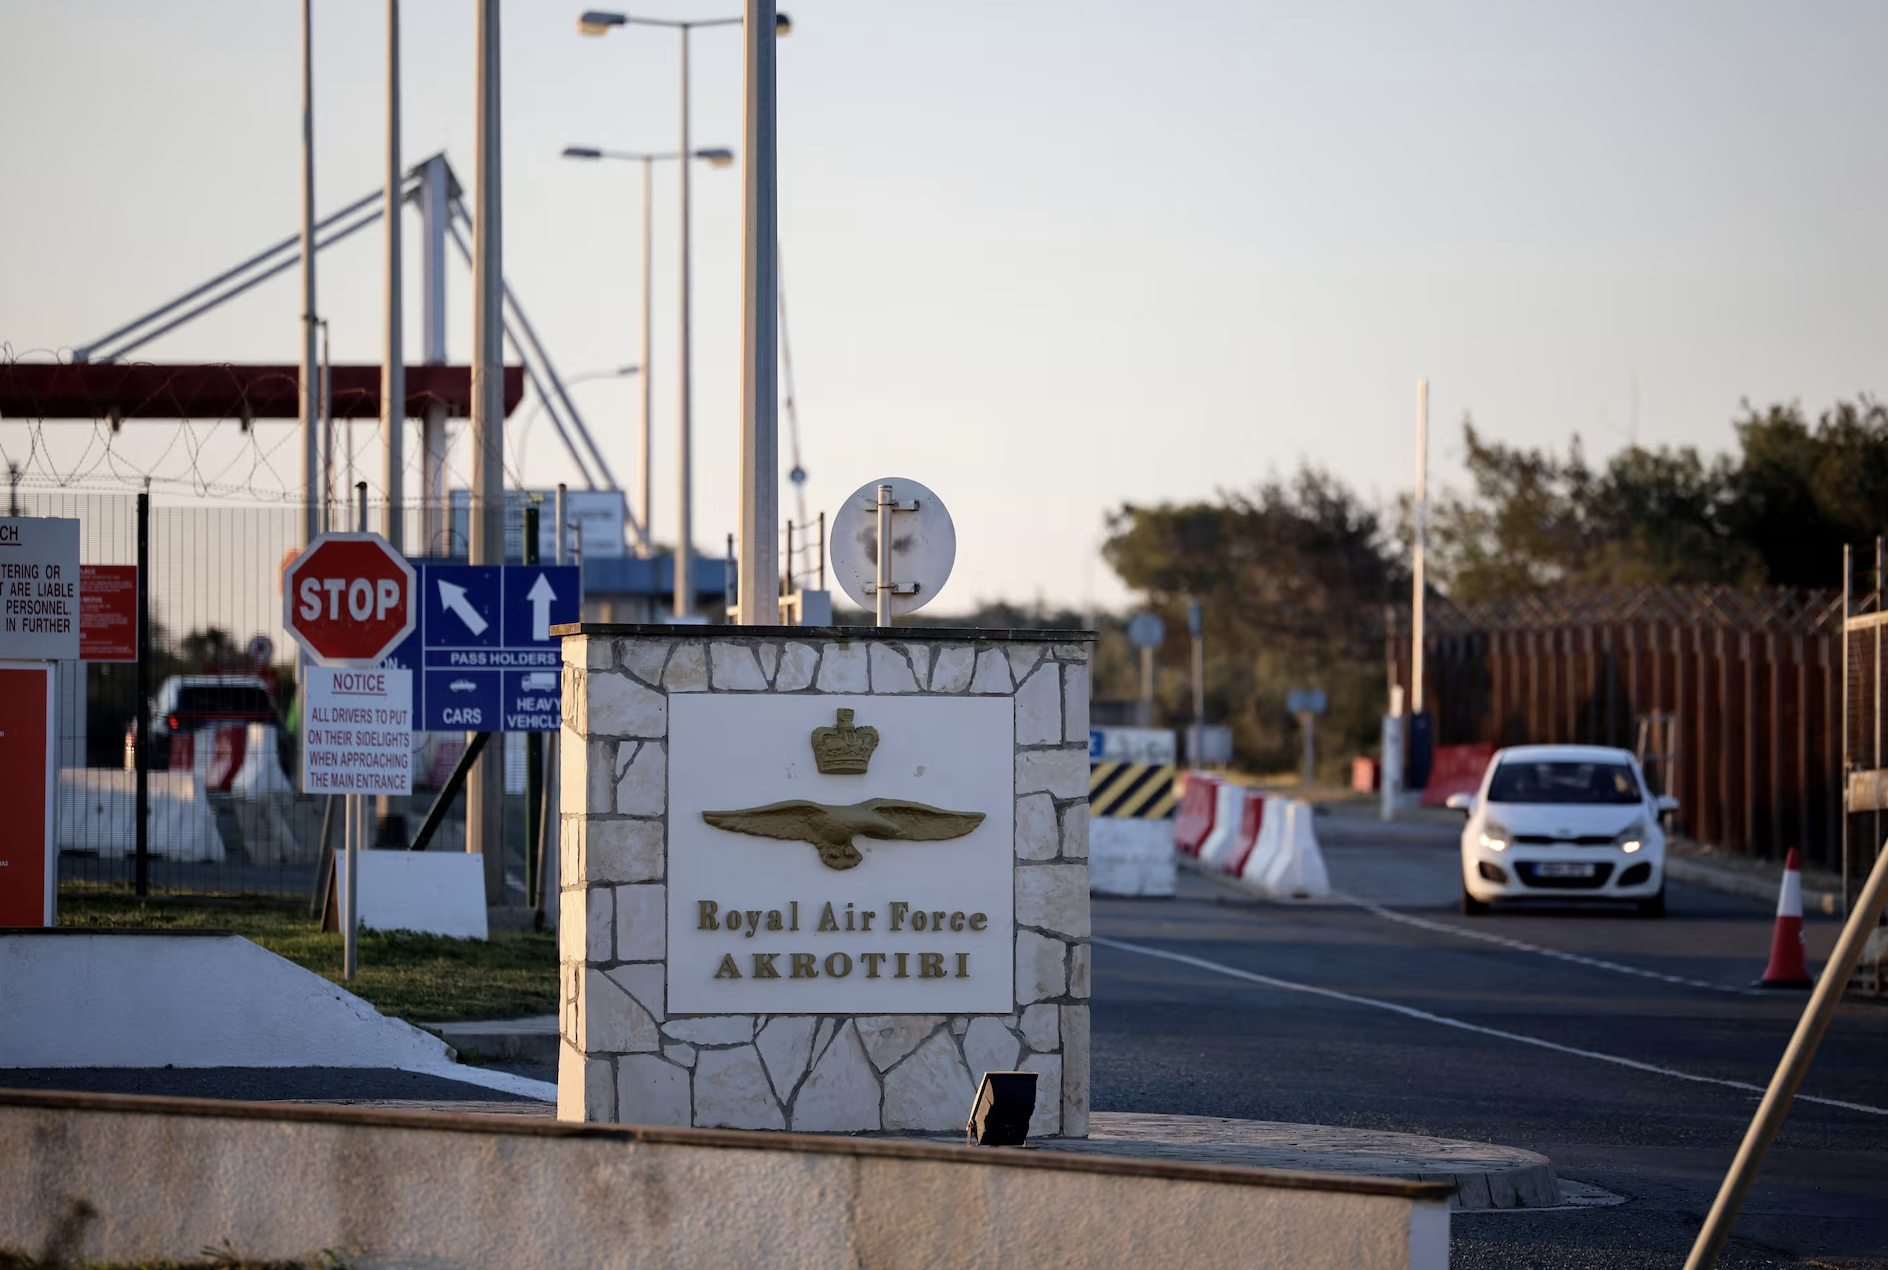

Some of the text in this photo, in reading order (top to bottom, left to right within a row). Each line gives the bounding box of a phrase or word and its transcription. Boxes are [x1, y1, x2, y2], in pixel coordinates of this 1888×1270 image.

[1, 564, 61, 580] TERING OR
[10, 582, 31, 597] ARE
[37, 583, 74, 598] LIABLE
[6, 599, 72, 615] PERSONNEL.
[299, 577, 400, 622] STOP
[6, 618, 16, 632] IN
[22, 618, 71, 633] FURTHER
[450, 652, 557, 666] PASS HOLDERS
[333, 673, 385, 691] NOTICE
[312, 707, 408, 725] ALL DRIVERS TO PUT
[442, 707, 482, 724] CARS
[308, 729, 410, 748] ON THEIR SIDELIGHTS
[309, 751, 408, 769] WHEN APPROACHING
[310, 772, 407, 790] THE MAIN ENTRANCE
[697, 900, 989, 938] Royal Air Force
[713, 952, 971, 979] AKROTIRI
